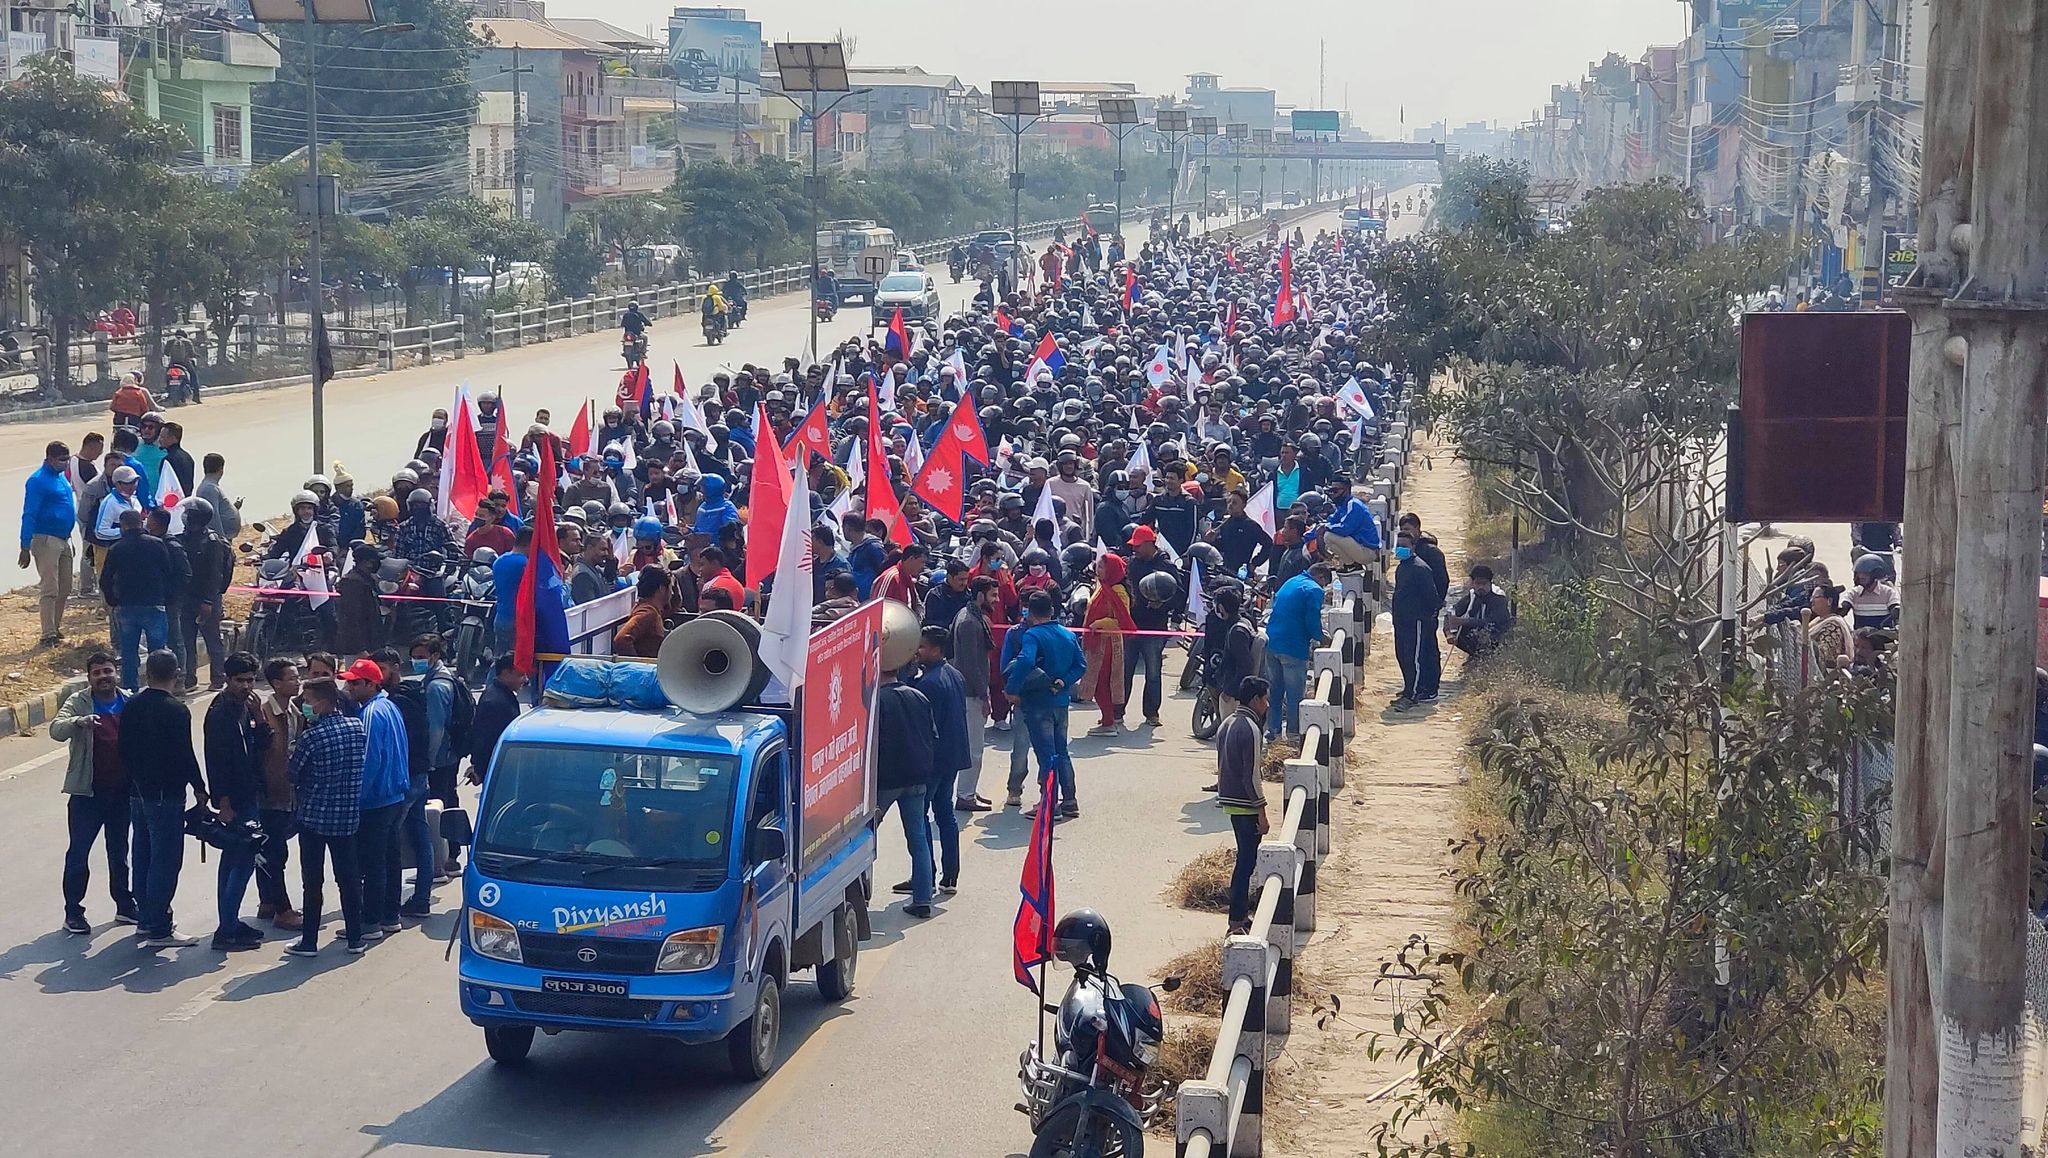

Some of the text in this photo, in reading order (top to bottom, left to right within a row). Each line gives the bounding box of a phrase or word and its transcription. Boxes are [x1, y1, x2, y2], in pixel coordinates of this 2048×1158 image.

[552, 892, 667, 929] Divyansh
[517, 919, 540, 930] ACE
[587, 983, 626, 996] ३७००
